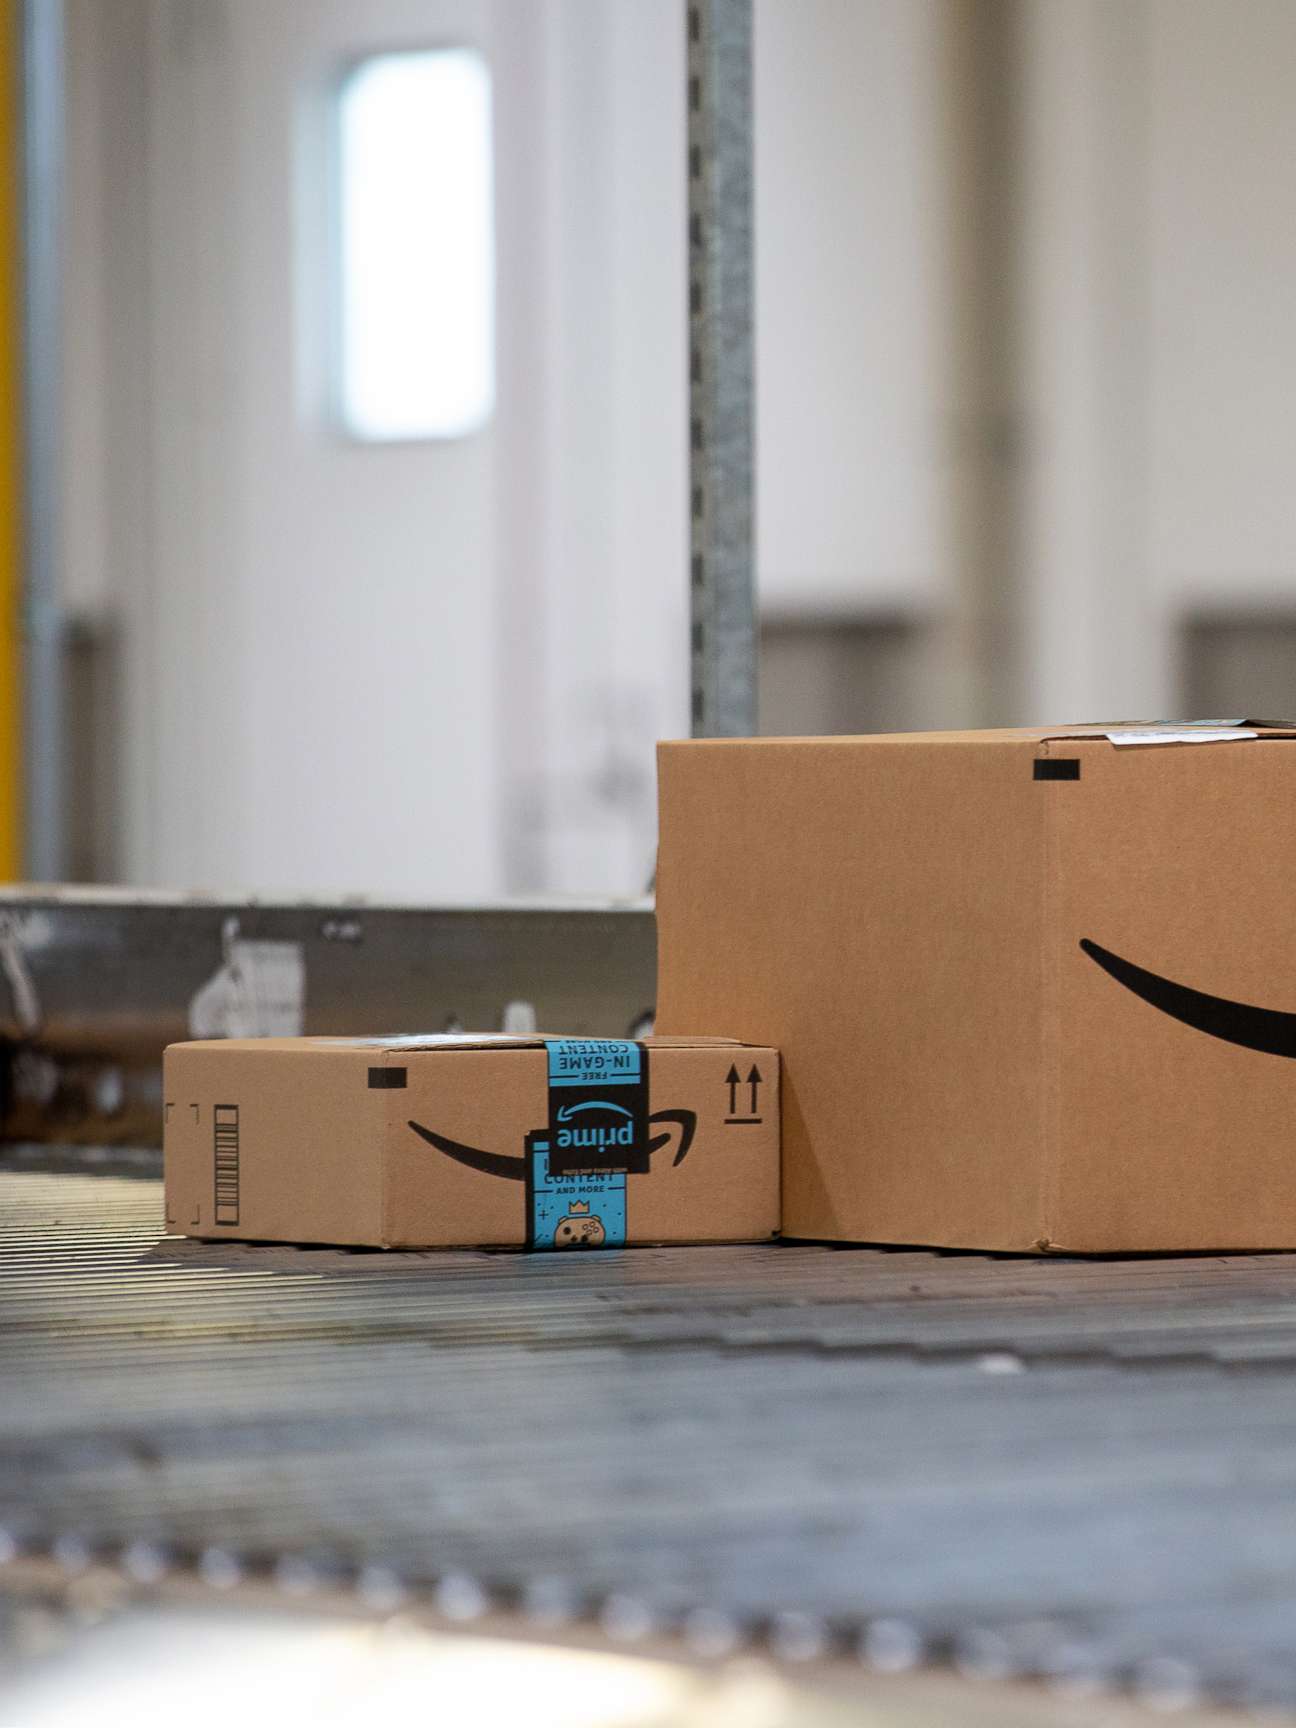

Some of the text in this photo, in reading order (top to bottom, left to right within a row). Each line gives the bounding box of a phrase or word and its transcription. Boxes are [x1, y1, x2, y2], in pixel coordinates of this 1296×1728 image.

[558, 1044, 629, 1055] CONTENT
[560, 1056, 630, 1069] IN-GAME
[581, 1072, 608, 1080] FREE
[557, 1121, 633, 1152] prime
[556, 1185, 605, 1195] AND MORE
